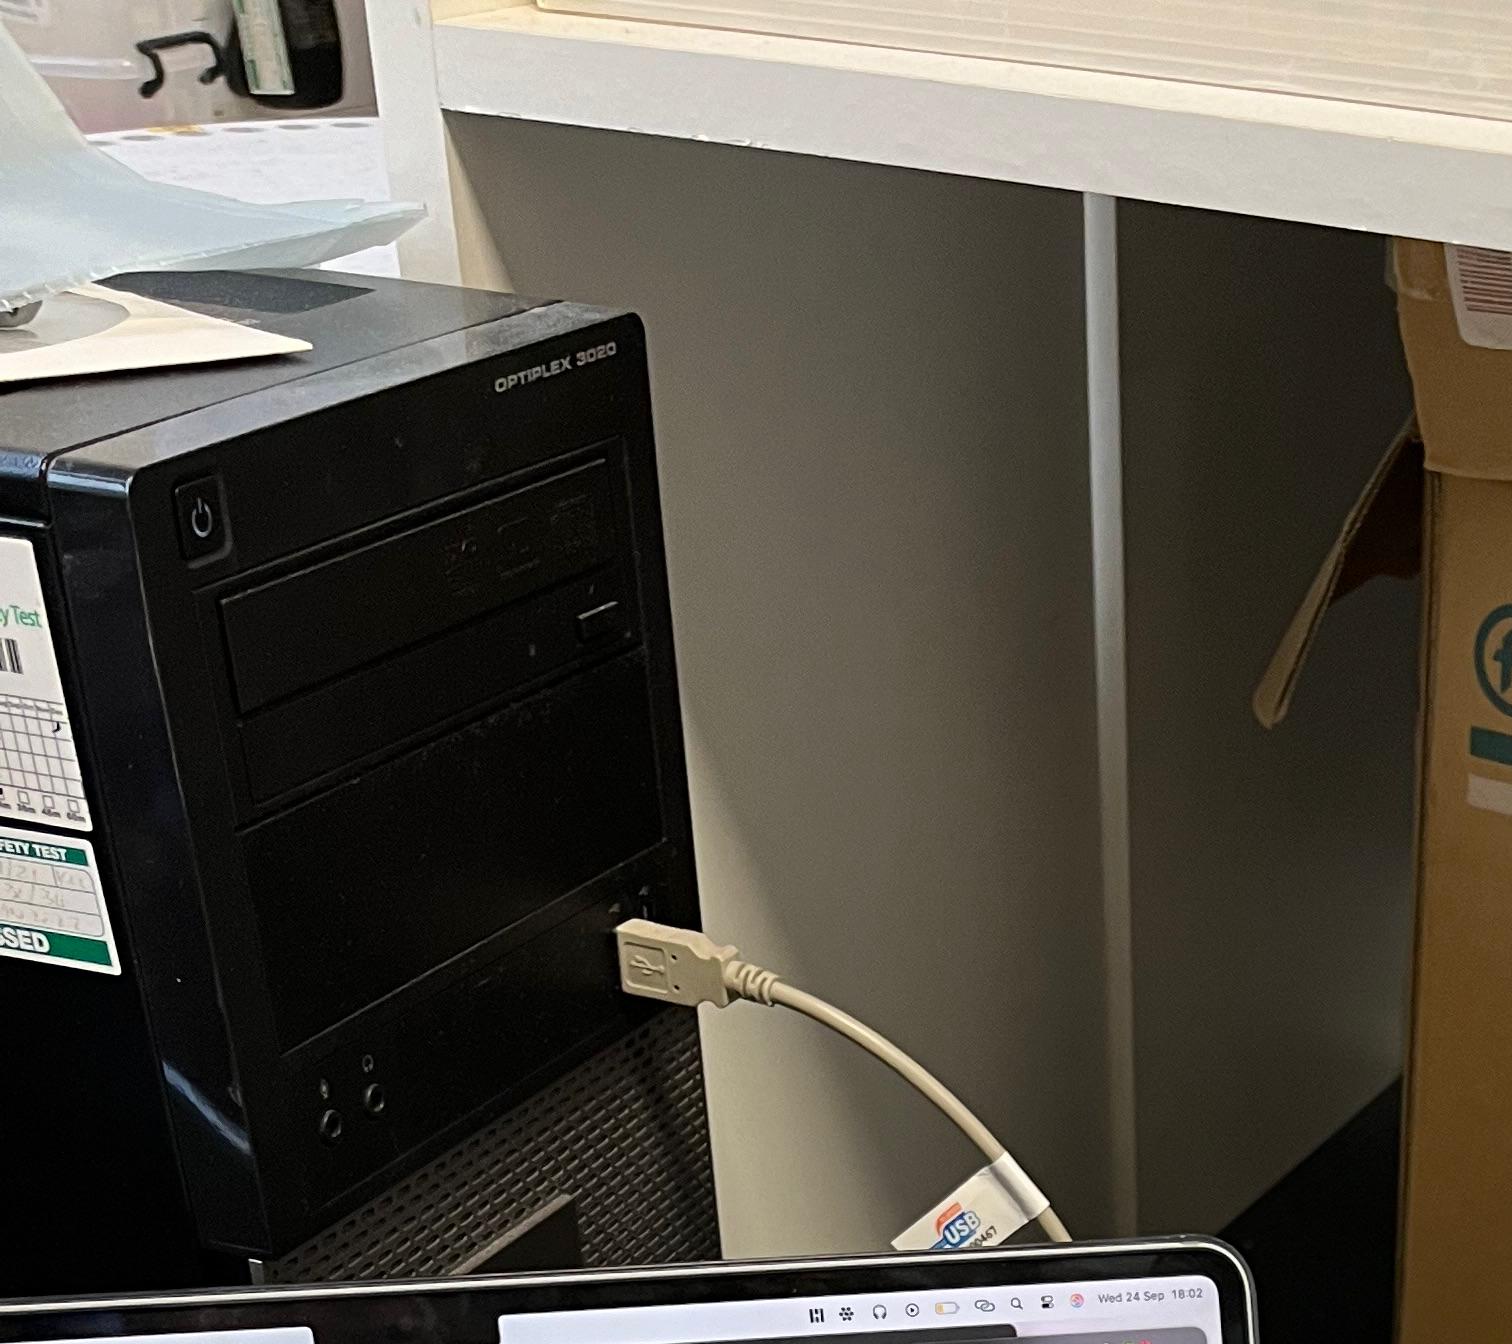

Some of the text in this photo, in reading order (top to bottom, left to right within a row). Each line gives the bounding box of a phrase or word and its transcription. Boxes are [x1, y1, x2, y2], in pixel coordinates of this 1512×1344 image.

[494, 341, 617, 393] OPTIPLEX 3020
[9, 604, 42, 628] Test
[32, 845, 67, 861] TEST
[944, 1211, 980, 1244] USB
[1098, 1288, 1203, 1303] Wed 24 Sep 18:02
